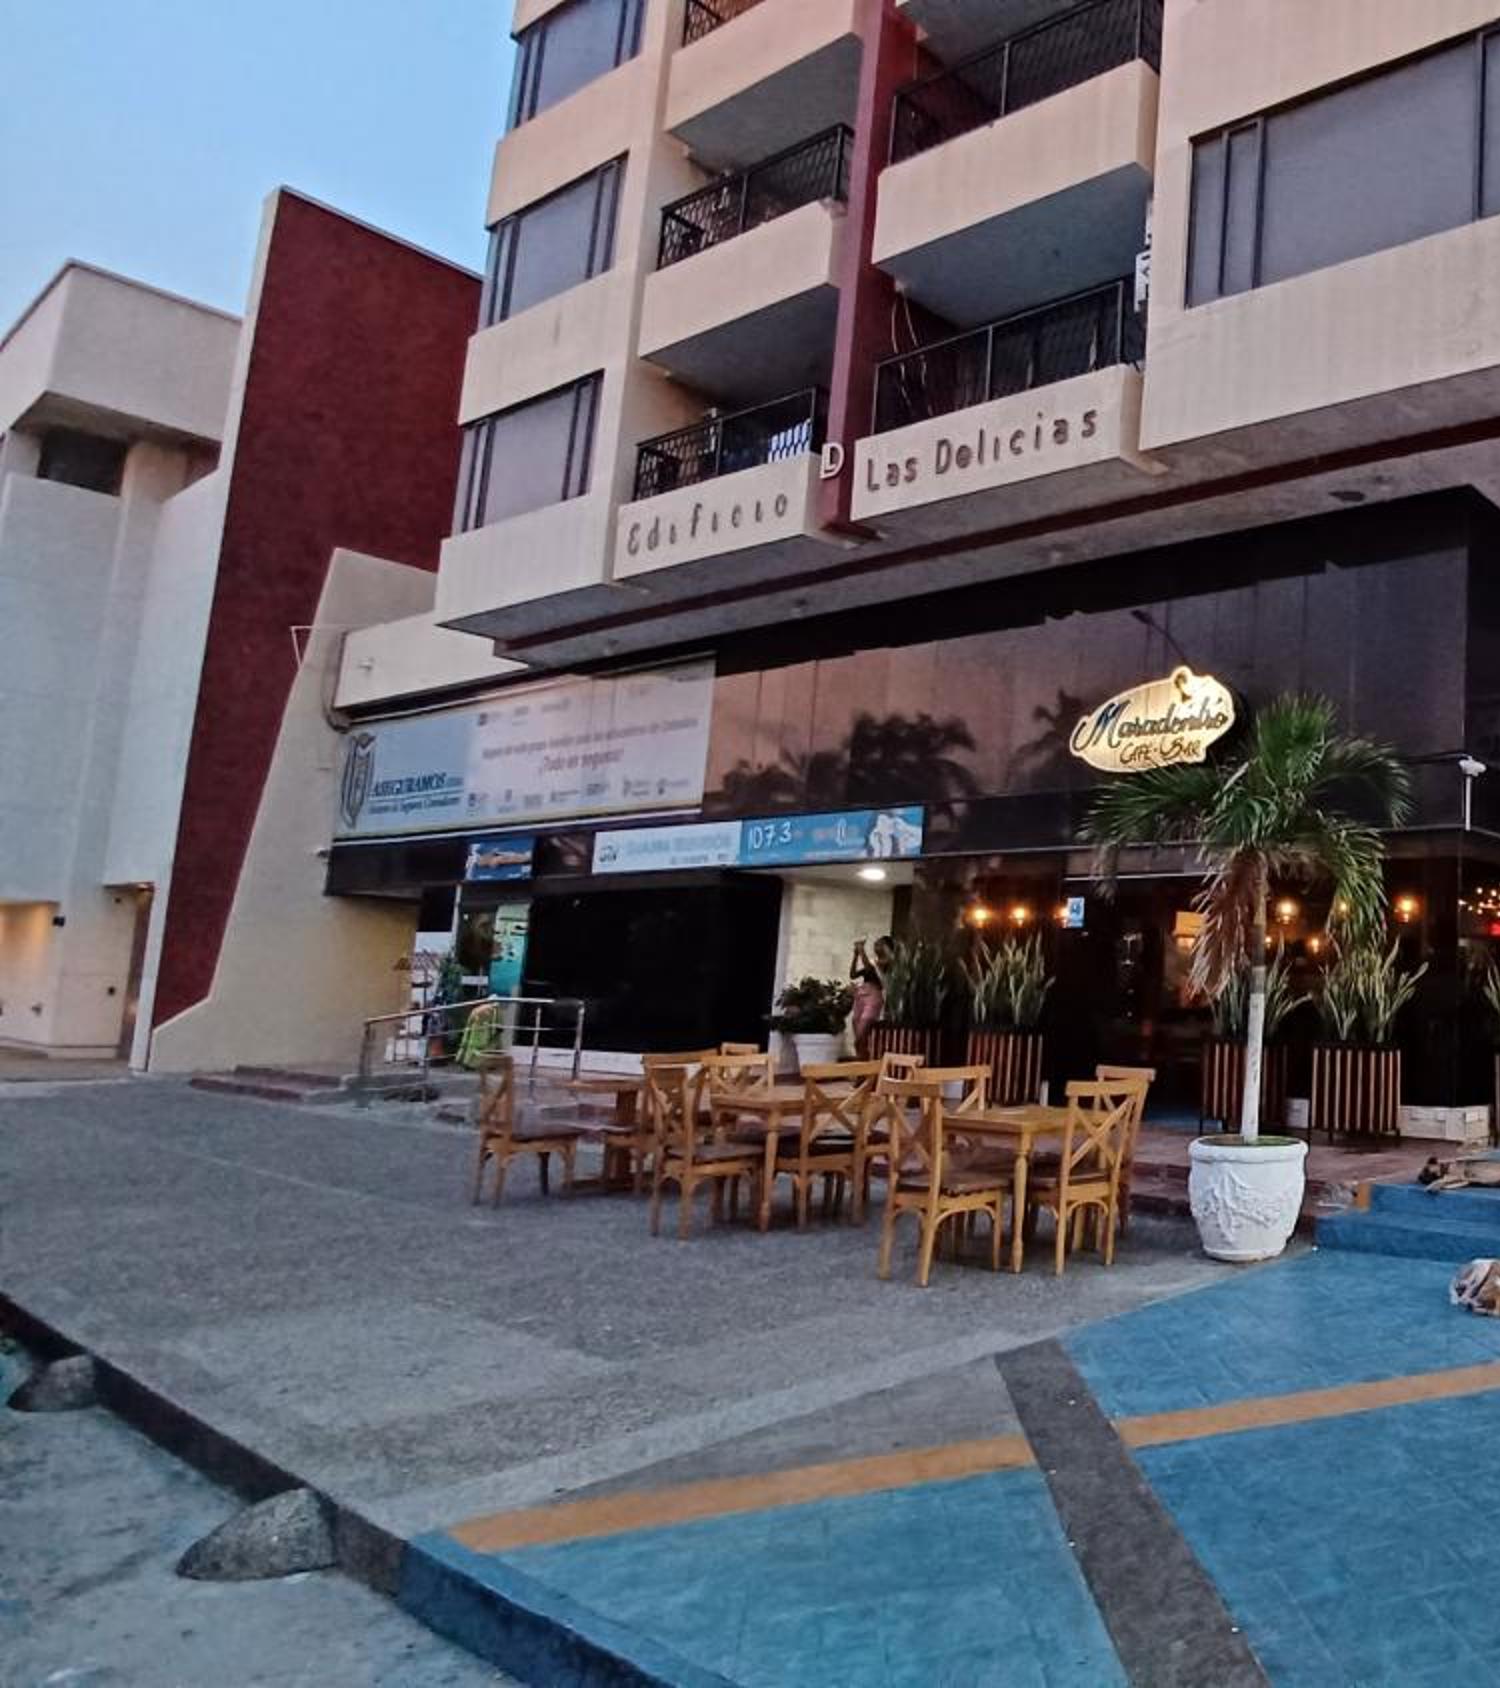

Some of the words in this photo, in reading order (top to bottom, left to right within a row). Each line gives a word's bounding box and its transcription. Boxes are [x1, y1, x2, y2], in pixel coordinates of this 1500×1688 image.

[866, 455, 919, 492] Las
[935, 407, 1099, 476] Delicias
[626, 492, 788, 557] Edificio
